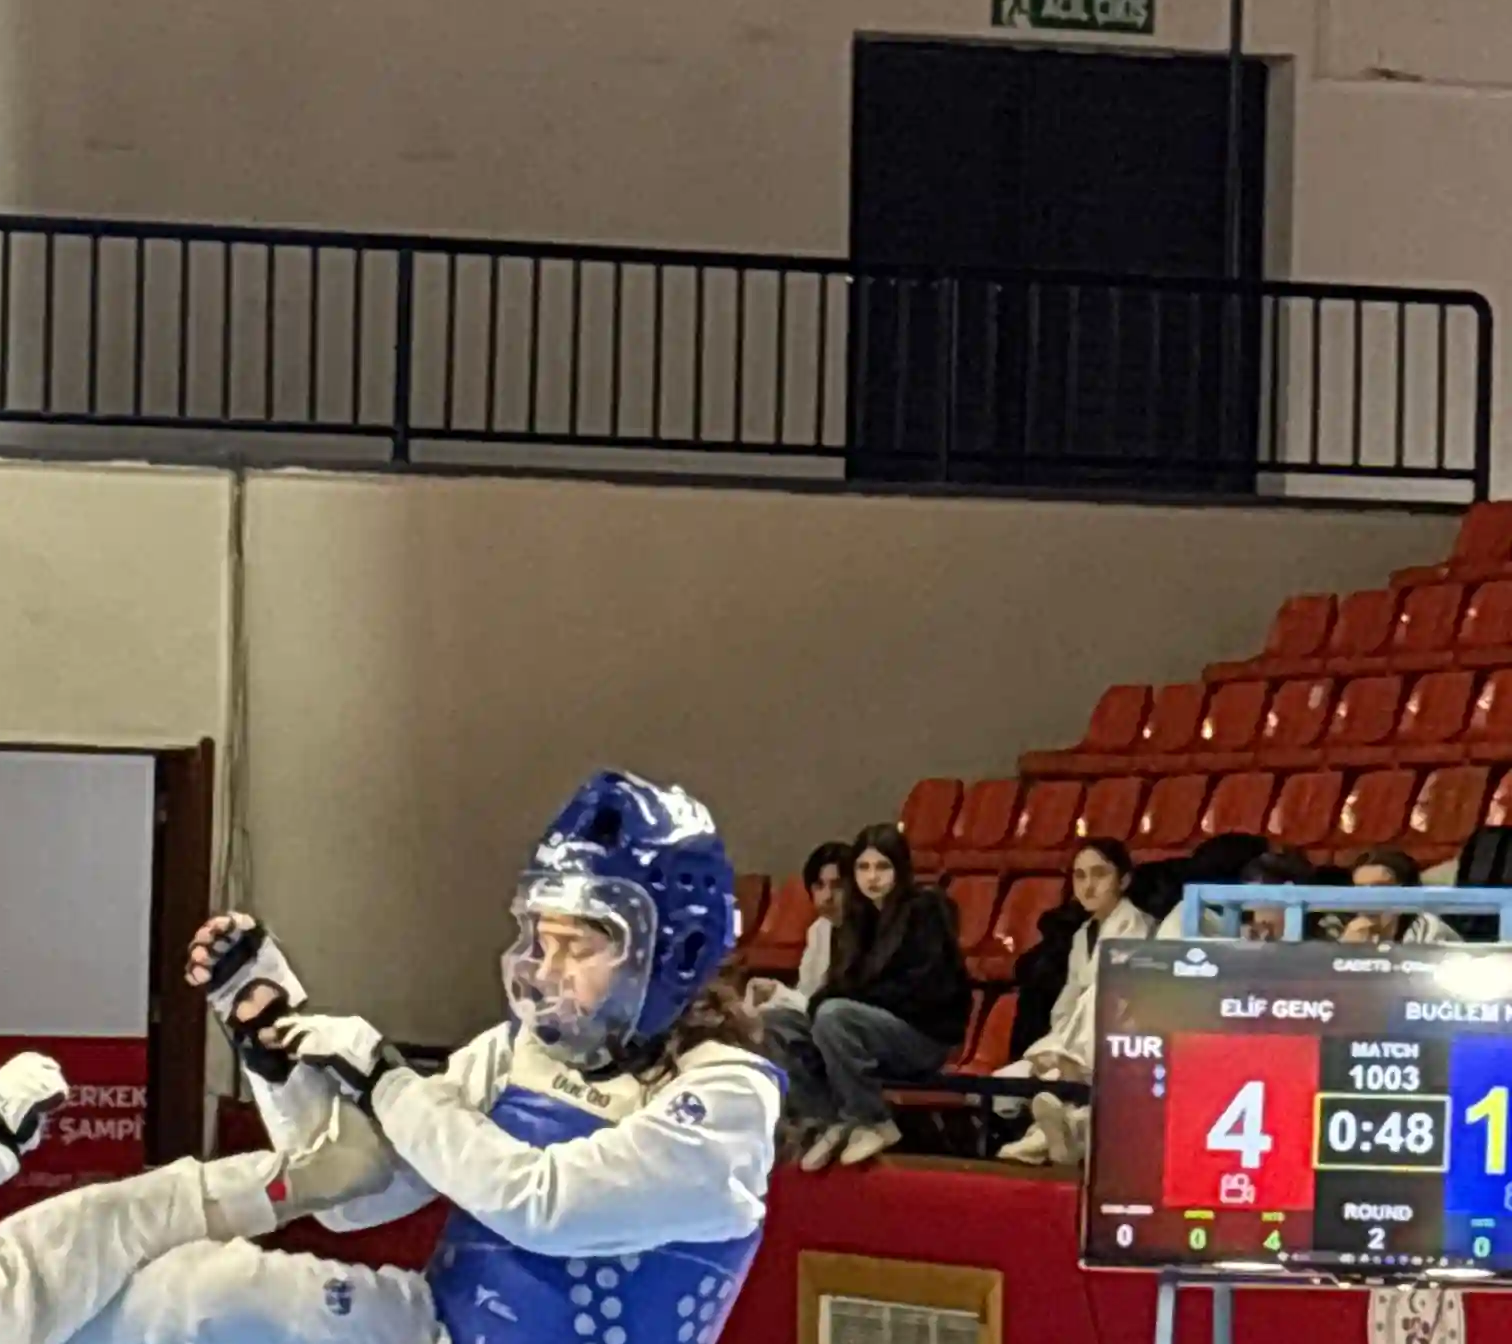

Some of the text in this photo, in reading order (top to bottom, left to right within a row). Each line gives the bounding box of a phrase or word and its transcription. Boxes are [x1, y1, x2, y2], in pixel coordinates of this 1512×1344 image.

[1220, 994, 1335, 1023] ELİF GENÇ
[1405, 1000, 1499, 1023] BUĞLEM
[1106, 1035, 1163, 1058] TUR
[1351, 1041, 1420, 1058] MATCH
[1348, 1064, 1421, 1091] 1003
[1206, 1081, 1272, 1168] 4
[1328, 1110, 1434, 1153] 0:48
[1465, 1086, 1508, 1175] 1
[1344, 1202, 1413, 1221] ROUND
[1116, 1224, 1133, 1247] 0
[1189, 1228, 1207, 1250] 0
[1368, 1227, 1386, 1250] 2
[1473, 1236, 1491, 1258] 0
